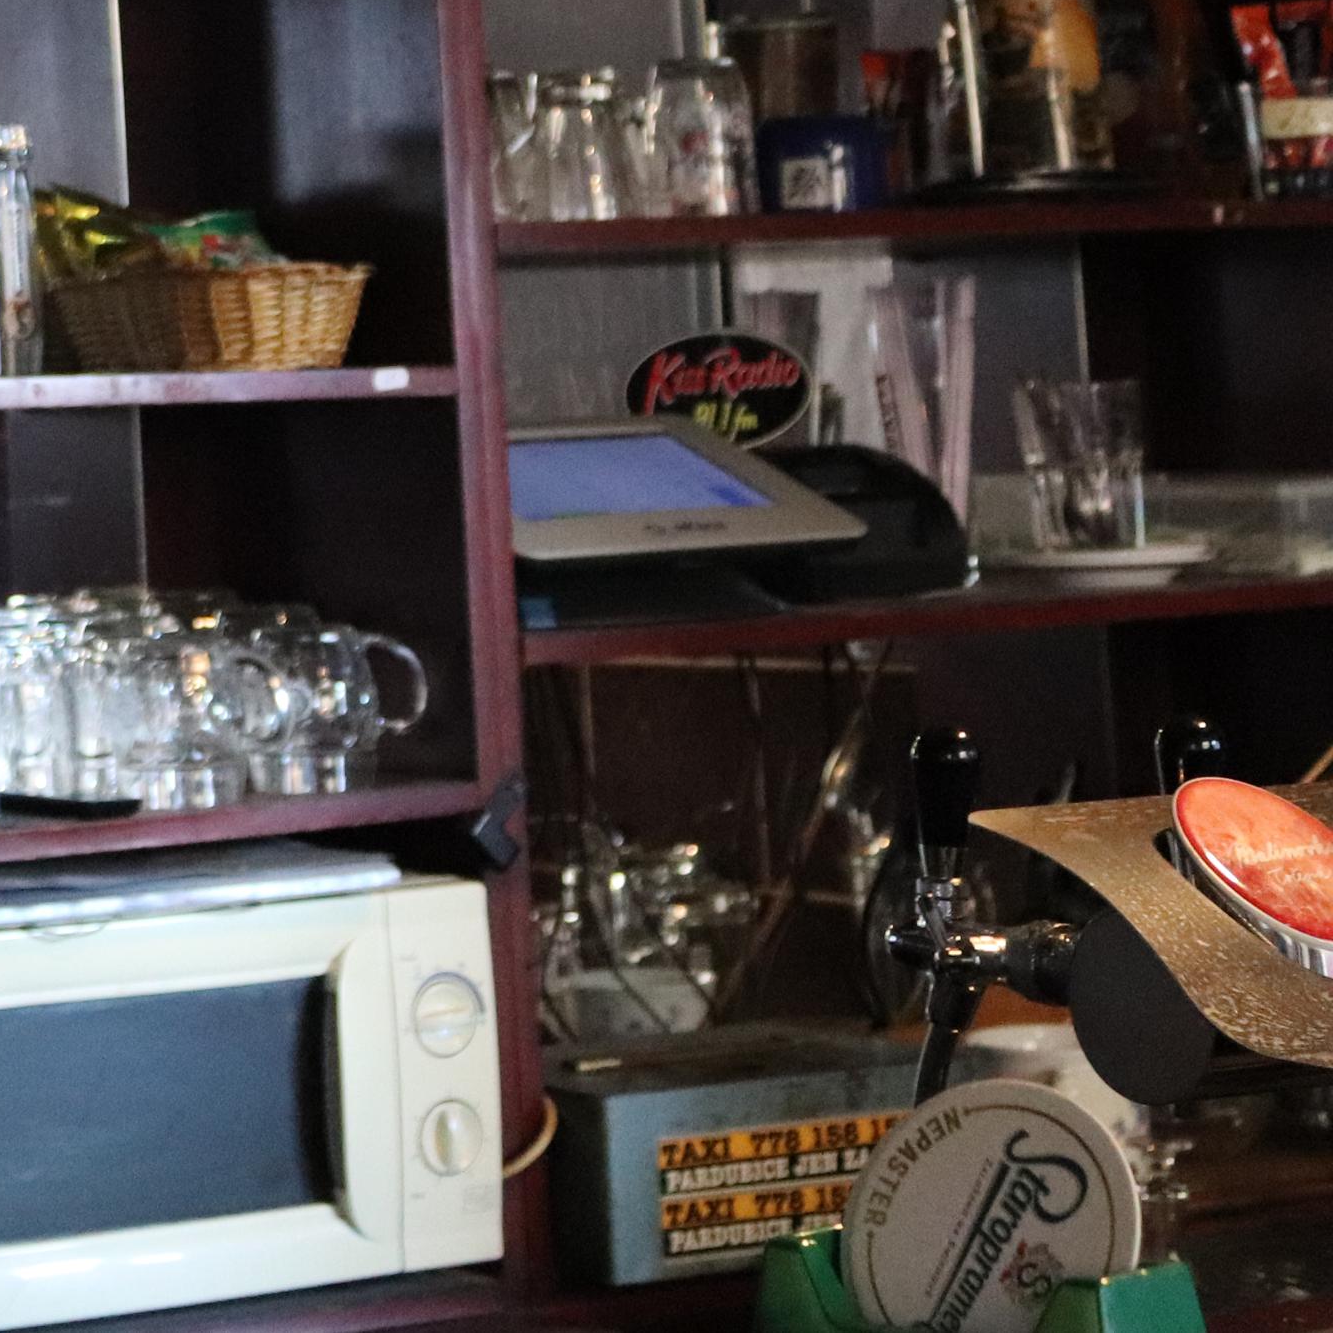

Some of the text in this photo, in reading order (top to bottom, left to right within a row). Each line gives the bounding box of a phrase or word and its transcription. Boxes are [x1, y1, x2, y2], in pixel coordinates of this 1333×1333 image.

[703, 347, 801, 402] Radio
[661, 1138, 731, 1167] TAXI
[750, 1130, 800, 1153] 778
[666, 1156, 789, 1194] PARDUBICE
[664, 1179, 854, 1226] TAXI 778 15
[670, 1218, 793, 1254] PARDUBICE
